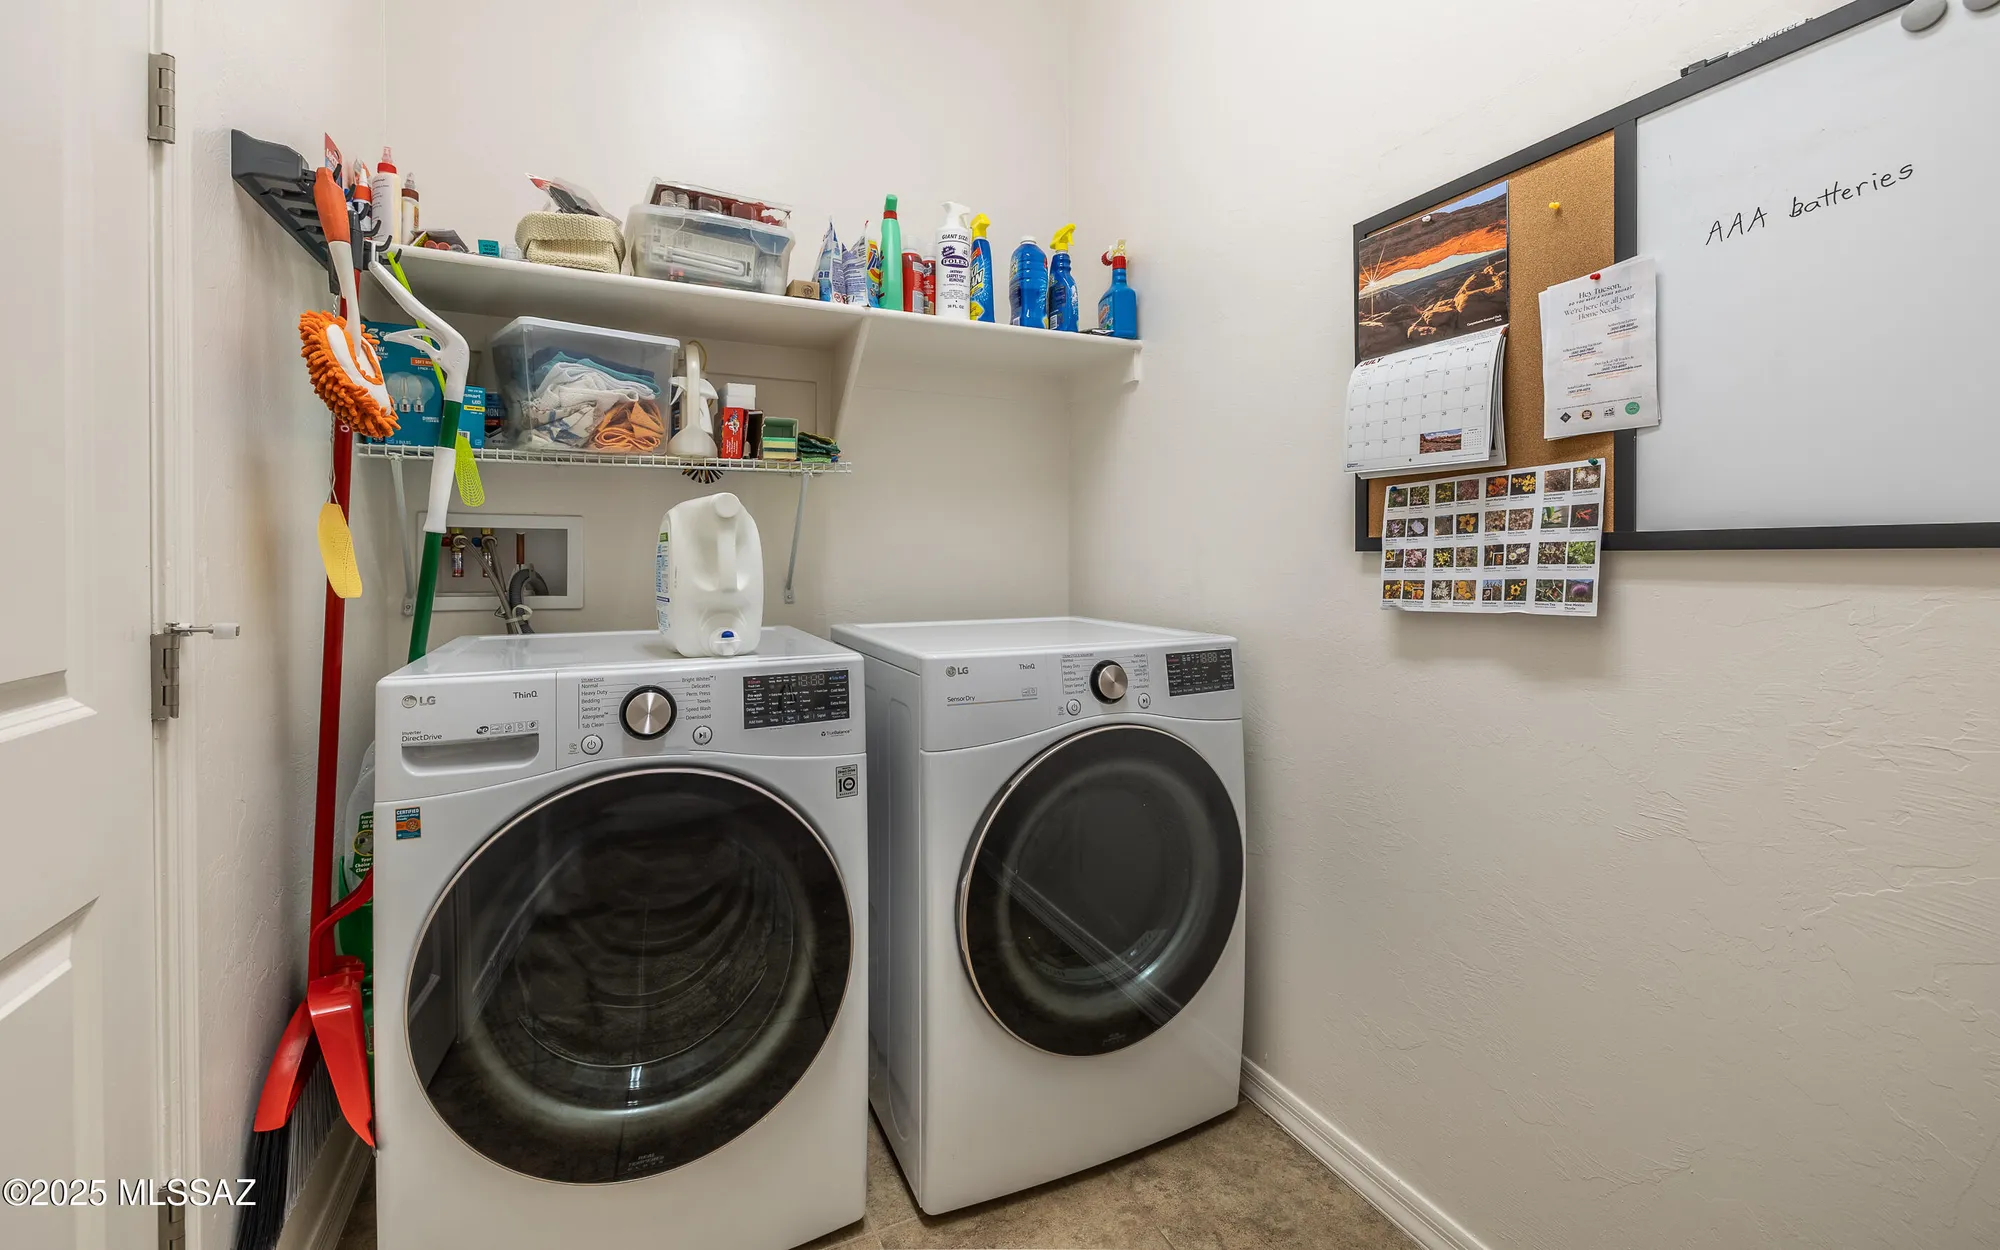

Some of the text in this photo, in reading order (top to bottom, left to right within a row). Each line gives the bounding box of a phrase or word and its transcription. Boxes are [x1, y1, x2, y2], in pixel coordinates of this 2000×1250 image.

[1706, 163, 1915, 246] AAA batteries
[1579, 283, 1622, 299] Hey Tucson,
[1564, 307, 1582, 316] We're
[1583, 303, 1598, 312] here
[1600, 300, 1609, 308] for
[1619, 293, 1636, 303] your
[1578, 311, 1598, 320] Home
[957, 666, 968, 675] LG
[419, 696, 436, 706] LG
[513, 690, 538, 700] ThinQ
[838, 777, 856, 792] 10
